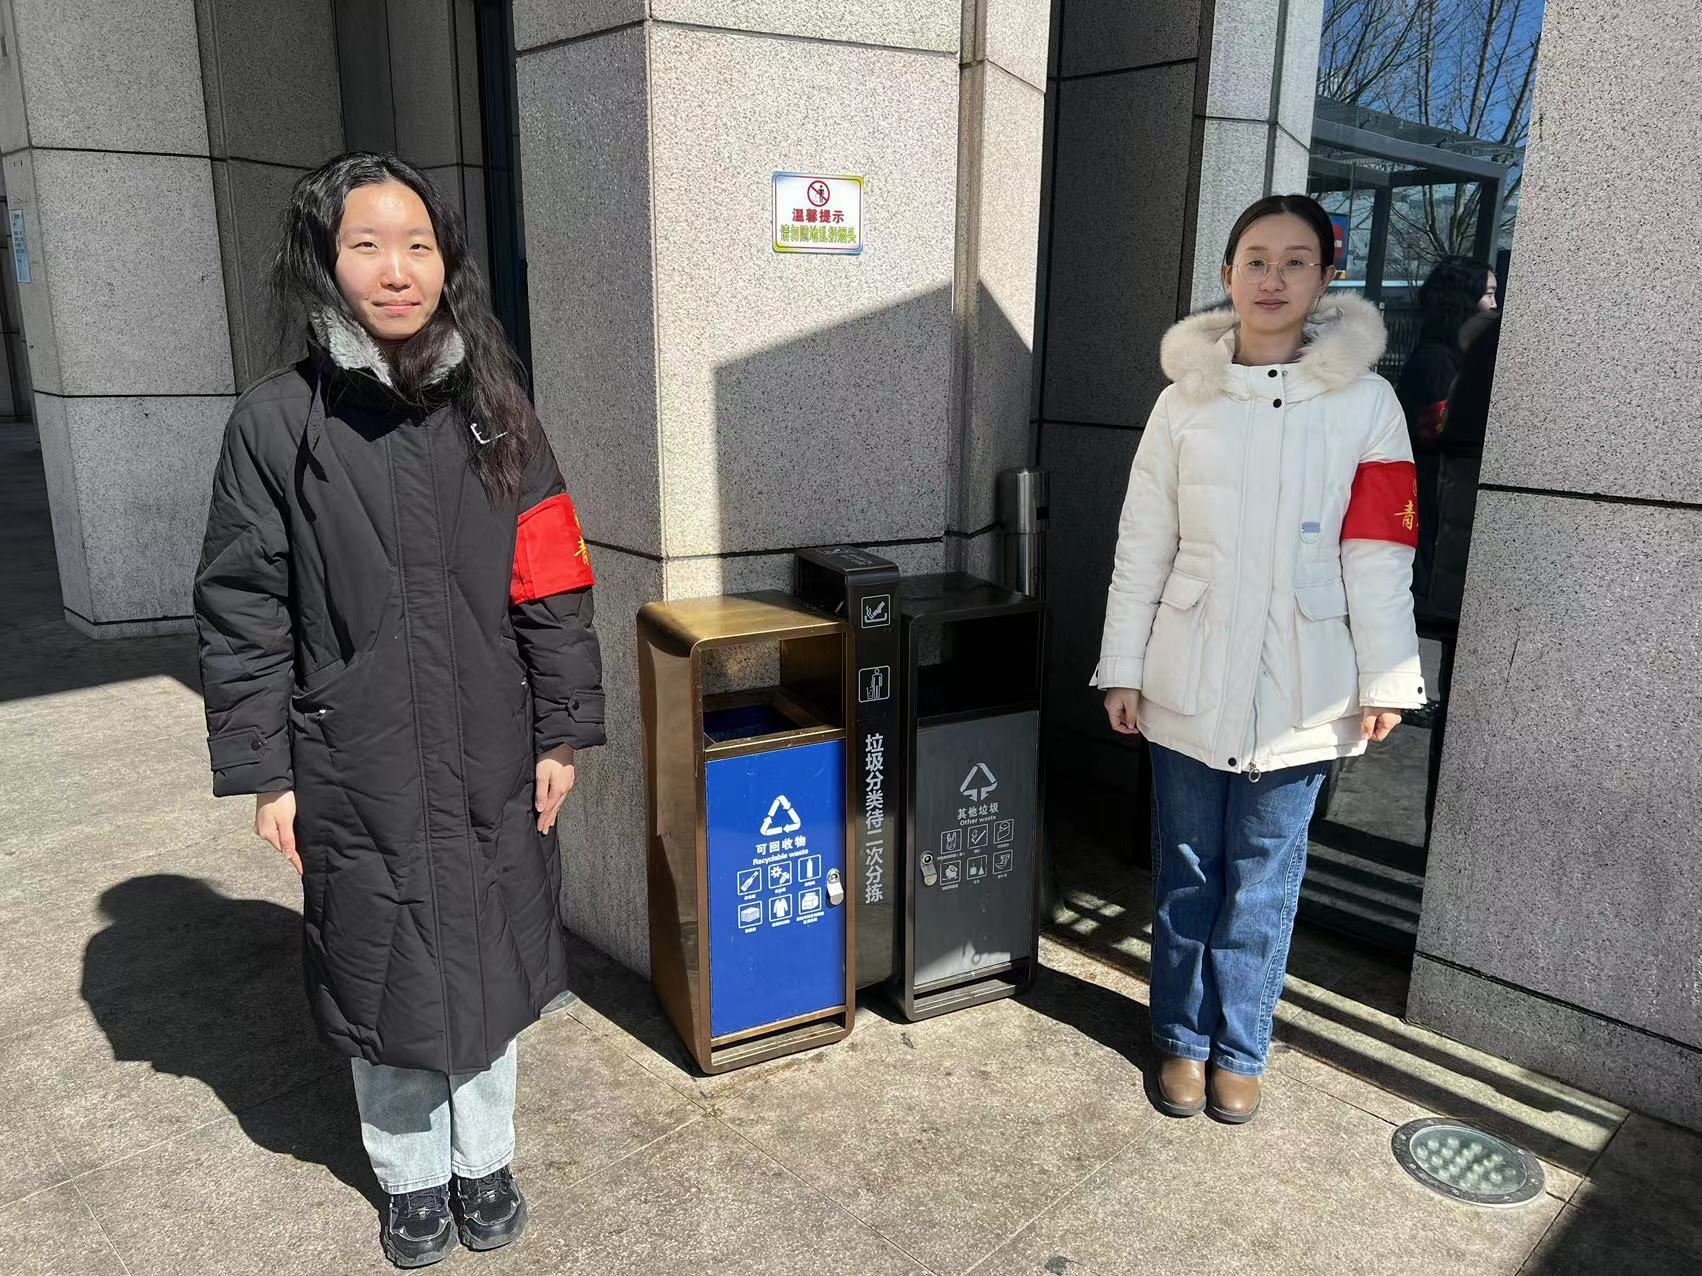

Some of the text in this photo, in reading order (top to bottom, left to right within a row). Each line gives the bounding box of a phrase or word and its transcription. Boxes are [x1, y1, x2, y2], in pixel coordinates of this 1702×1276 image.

[792, 208, 845, 223] 温馨提示
[780, 224, 857, 244] 请勿随地乱扔烟头
[1394, 499, 1418, 531] 青
[865, 732, 884, 904] 垃圾分类待二次分拣
[957, 802, 999, 820] 其他垃圾
[959, 815, 997, 826] Other waste
[755, 835, 806, 855] 可回收物
[752, 849, 809, 866] Recyclable waste
